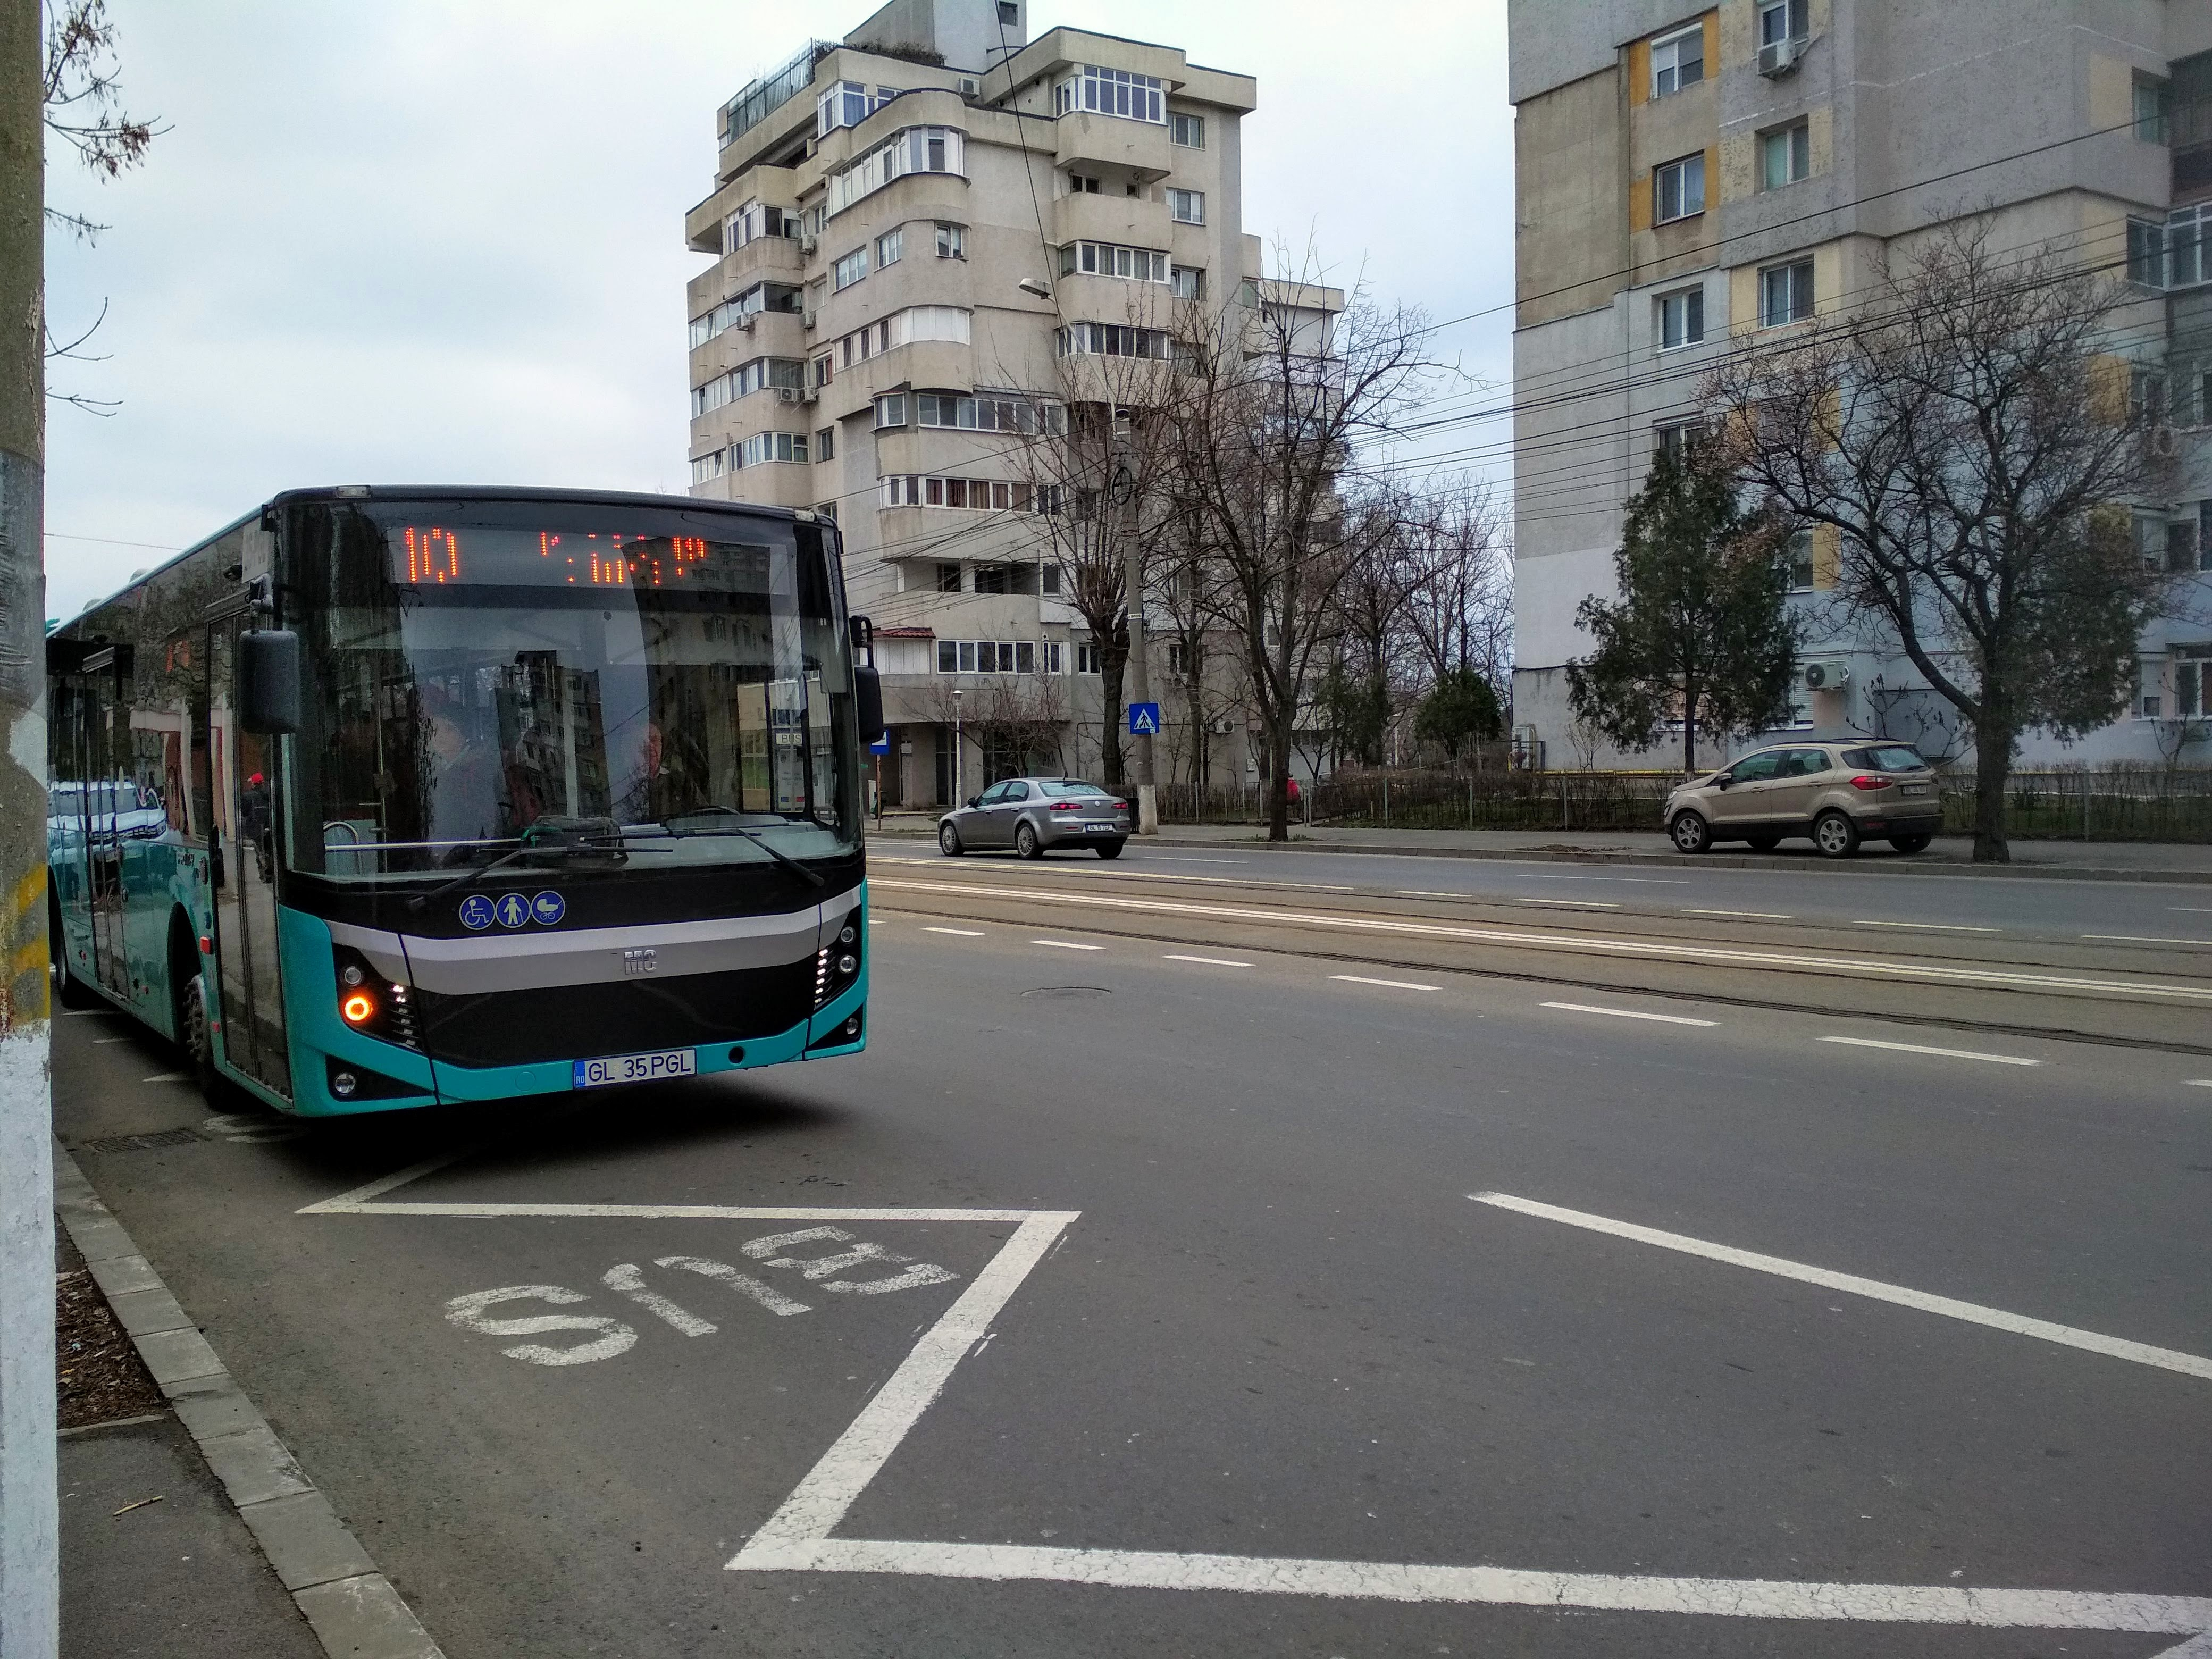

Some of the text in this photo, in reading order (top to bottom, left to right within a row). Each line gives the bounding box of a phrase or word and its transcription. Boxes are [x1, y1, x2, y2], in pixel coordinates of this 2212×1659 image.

[782, 734, 801, 743] BUS
[589, 1053, 691, 1082] GL 35 PGL
[576, 1075, 585, 1084] RO
[443, 1225, 960, 1366] BUS
